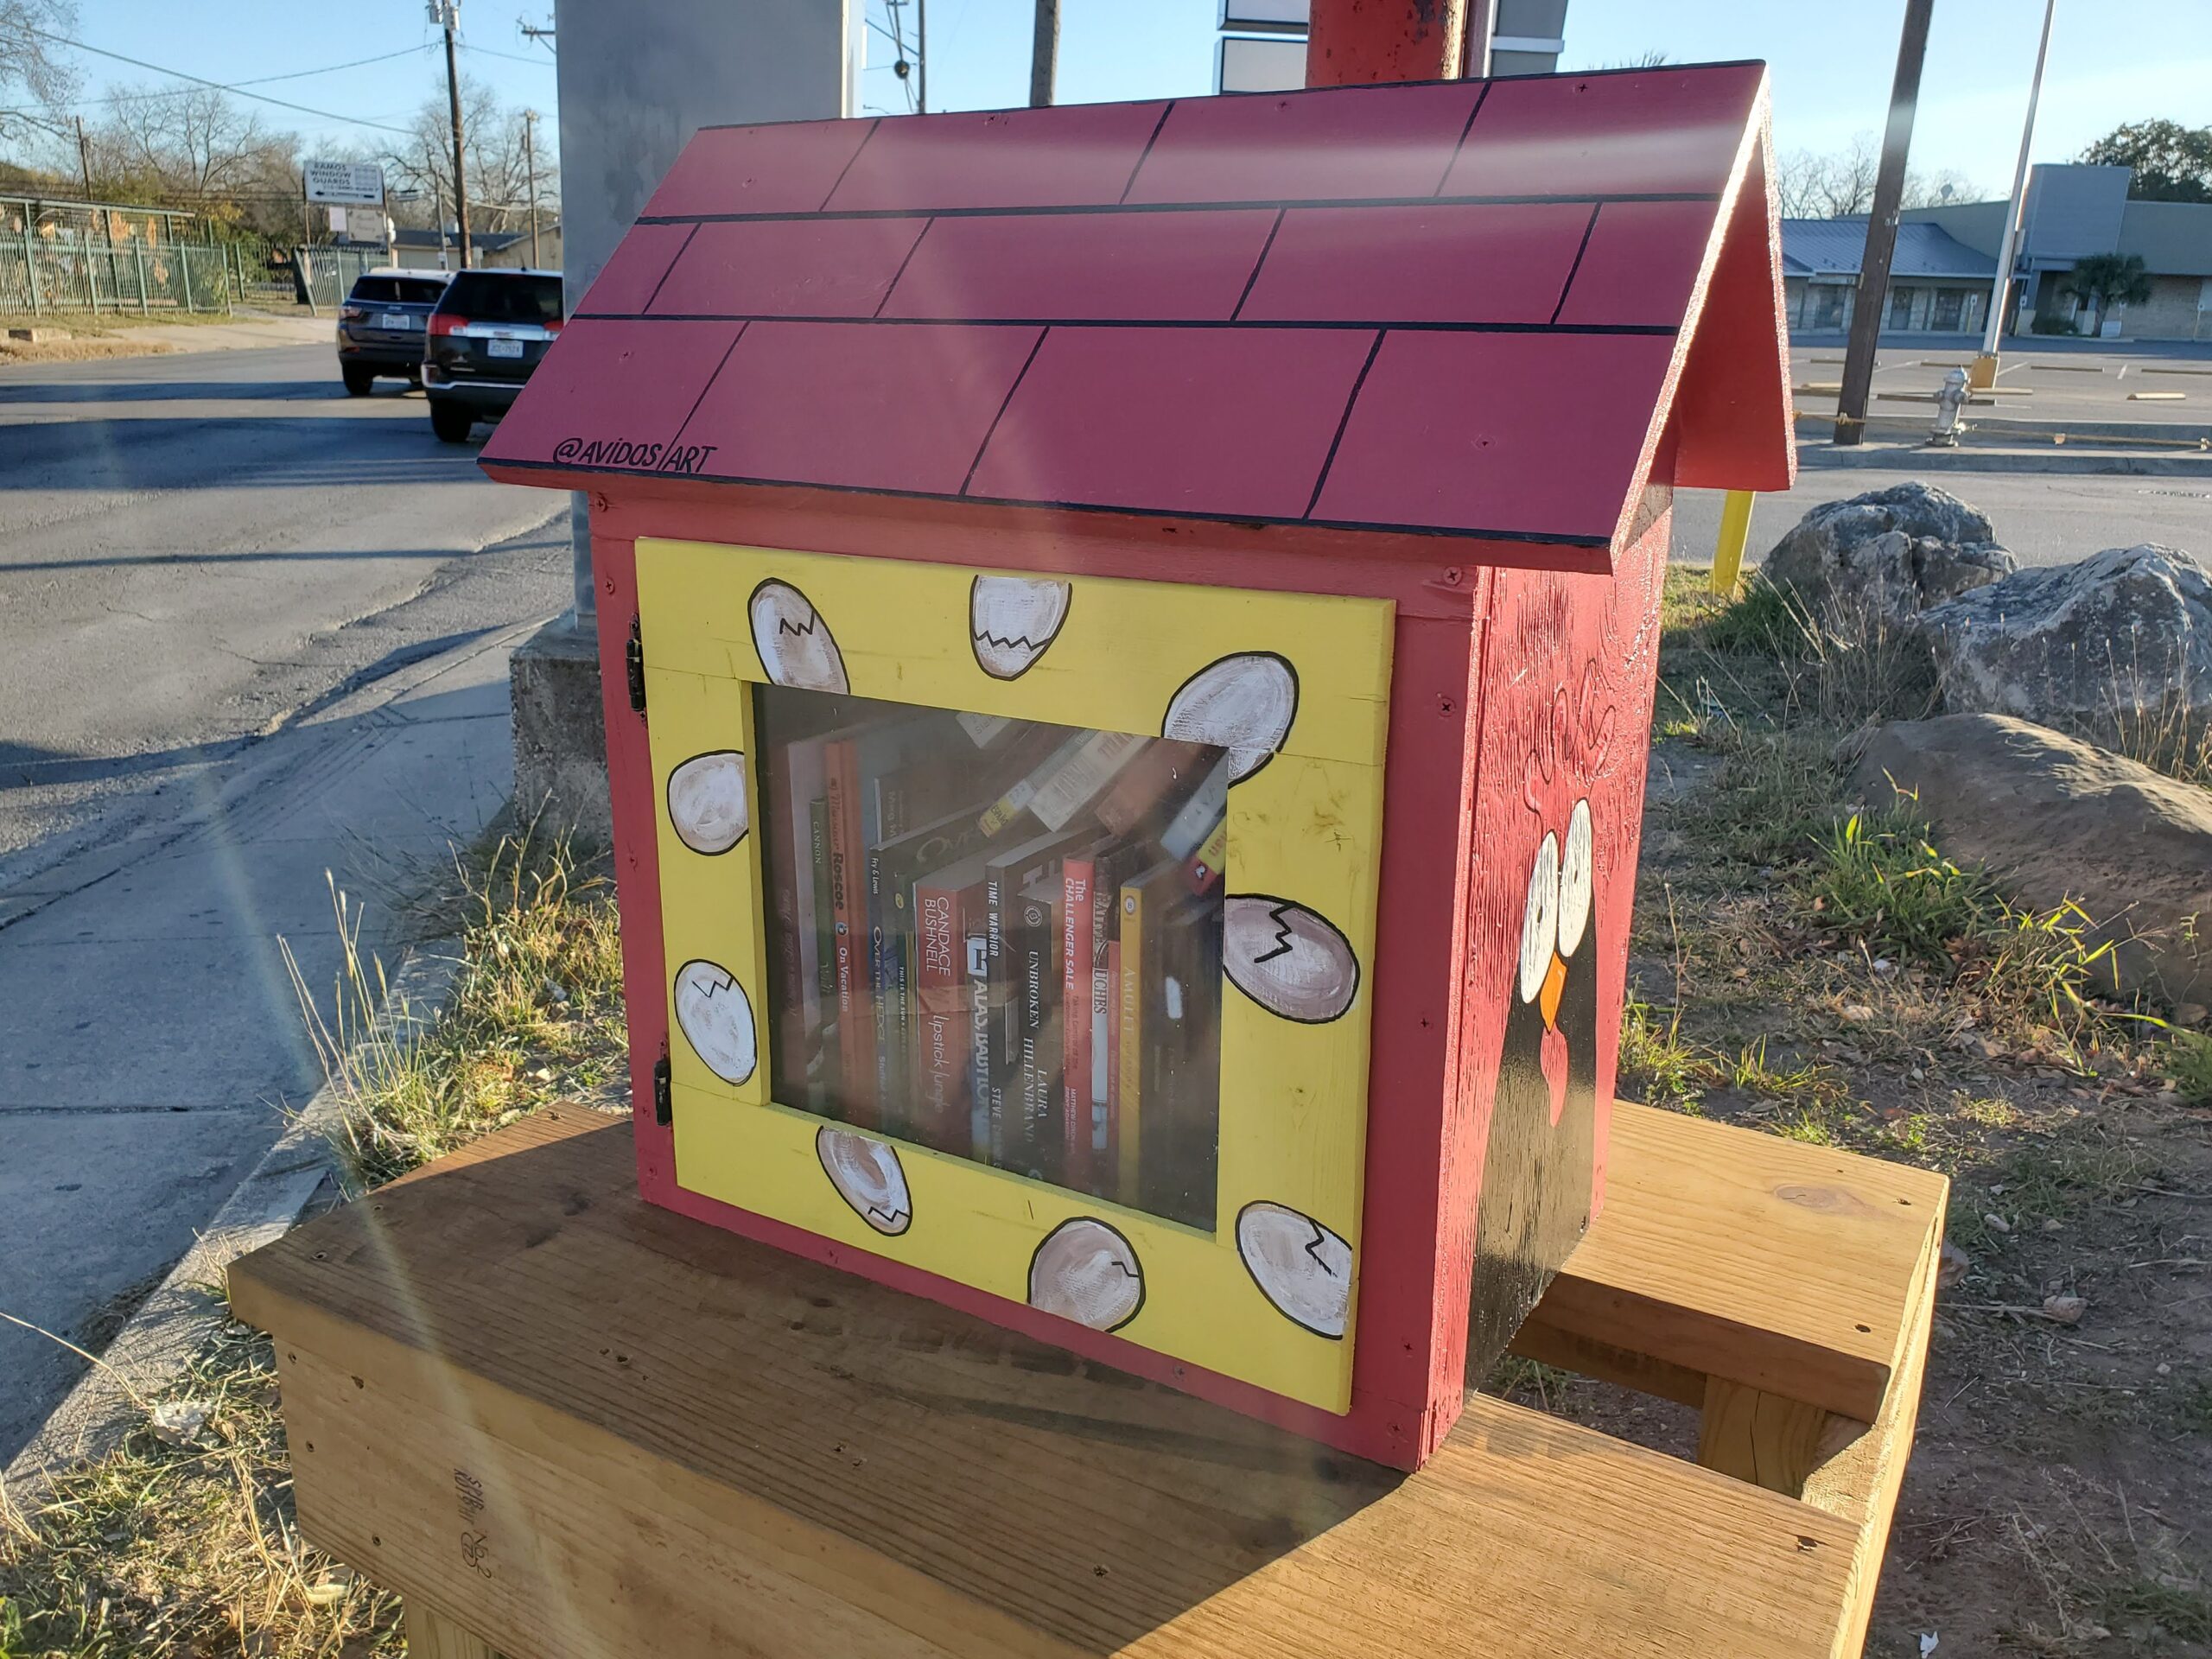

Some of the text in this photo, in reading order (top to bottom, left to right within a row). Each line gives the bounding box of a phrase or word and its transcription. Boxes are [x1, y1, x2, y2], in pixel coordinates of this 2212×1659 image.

[309, 169, 352, 178] WINDOW
[812, 820, 822, 865] CANNON
[870, 857, 879, 868] Fry
[832, 852, 845, 910] Roscoe
[1075, 879, 1086, 902] The
[925, 898, 938, 973] BUSHNELL
[936, 896, 950, 976] CANDACE
[988, 880, 999, 957] TIME WARRIOR
[1065, 877, 1074, 989] CHALLENGER SALE
[839, 946, 849, 963] On
[840, 965, 850, 1012] Vacation
[899, 982, 905, 991] IS
[1027, 950, 1039, 1030] UNBROKEN
[1123, 966, 1136, 1036] AMULET
[875, 995, 885, 1047] HEDGE
[991, 1087, 1001, 1119] STEVE
[1022, 1037, 1035, 1145] HILLENBRAND
[1037, 1069, 1048, 1118] LAURA
